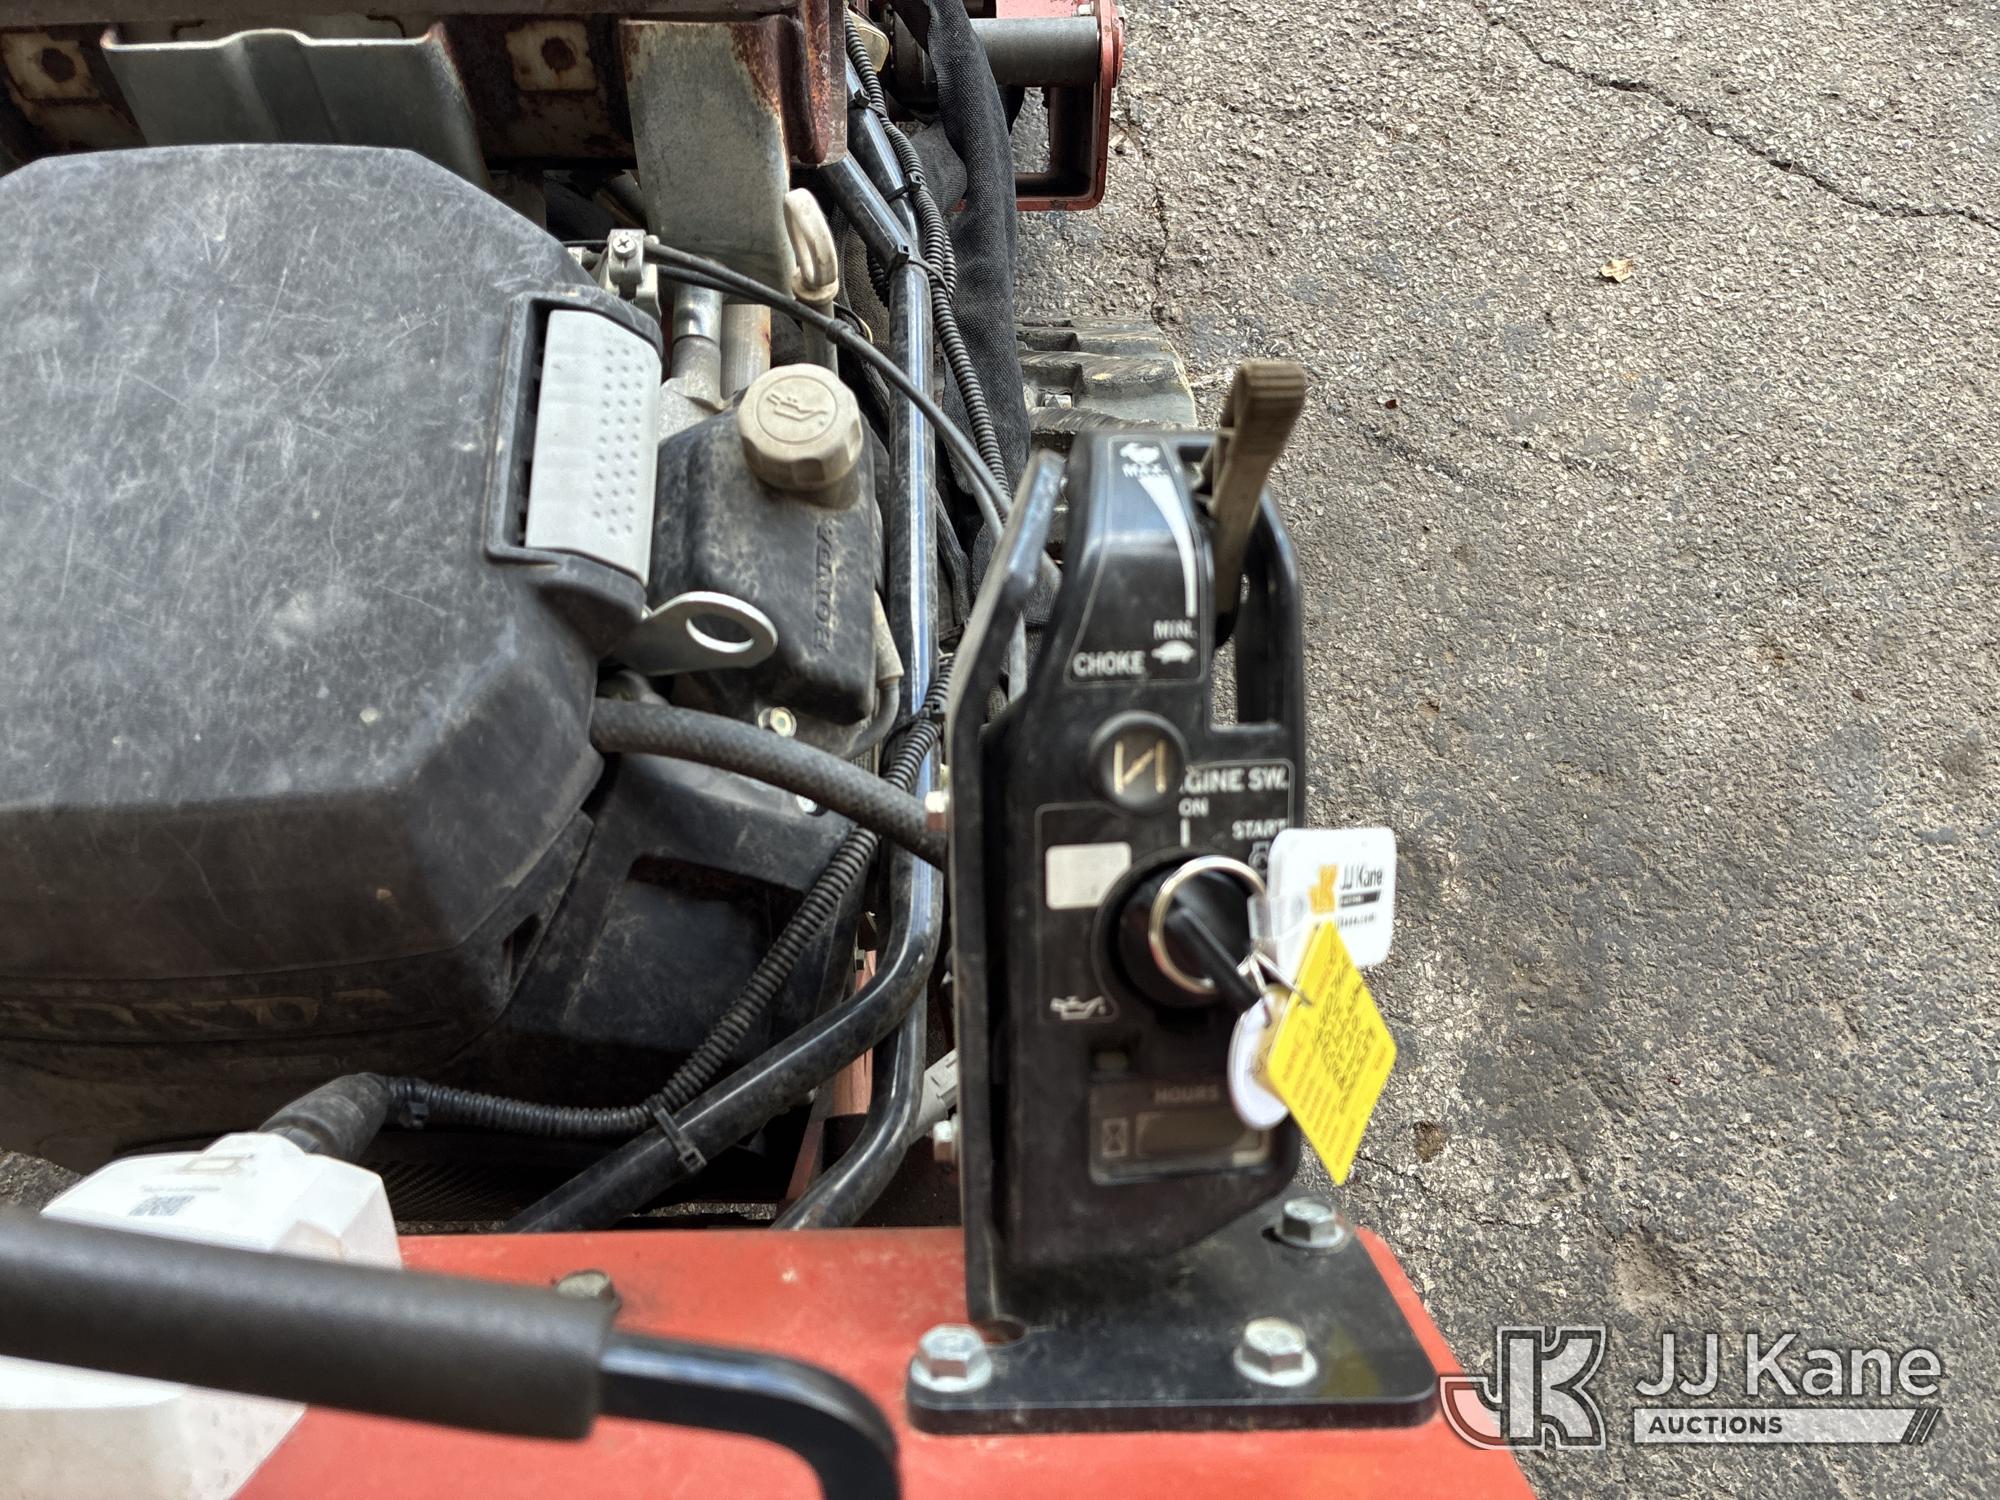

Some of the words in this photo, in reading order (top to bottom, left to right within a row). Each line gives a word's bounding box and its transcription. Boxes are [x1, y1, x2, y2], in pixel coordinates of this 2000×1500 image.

[1153, 620, 1198, 640] MIN.
[1073, 651, 1146, 677] CHOKE
[1179, 765, 1245, 794] GINE
[1247, 766, 1289, 791] SW.
[1179, 797, 1209, 818] ON
[1231, 818, 1288, 840] START
[1356, 863, 1384, 888] Kane
[1154, 1085, 1219, 1104] HOURS
